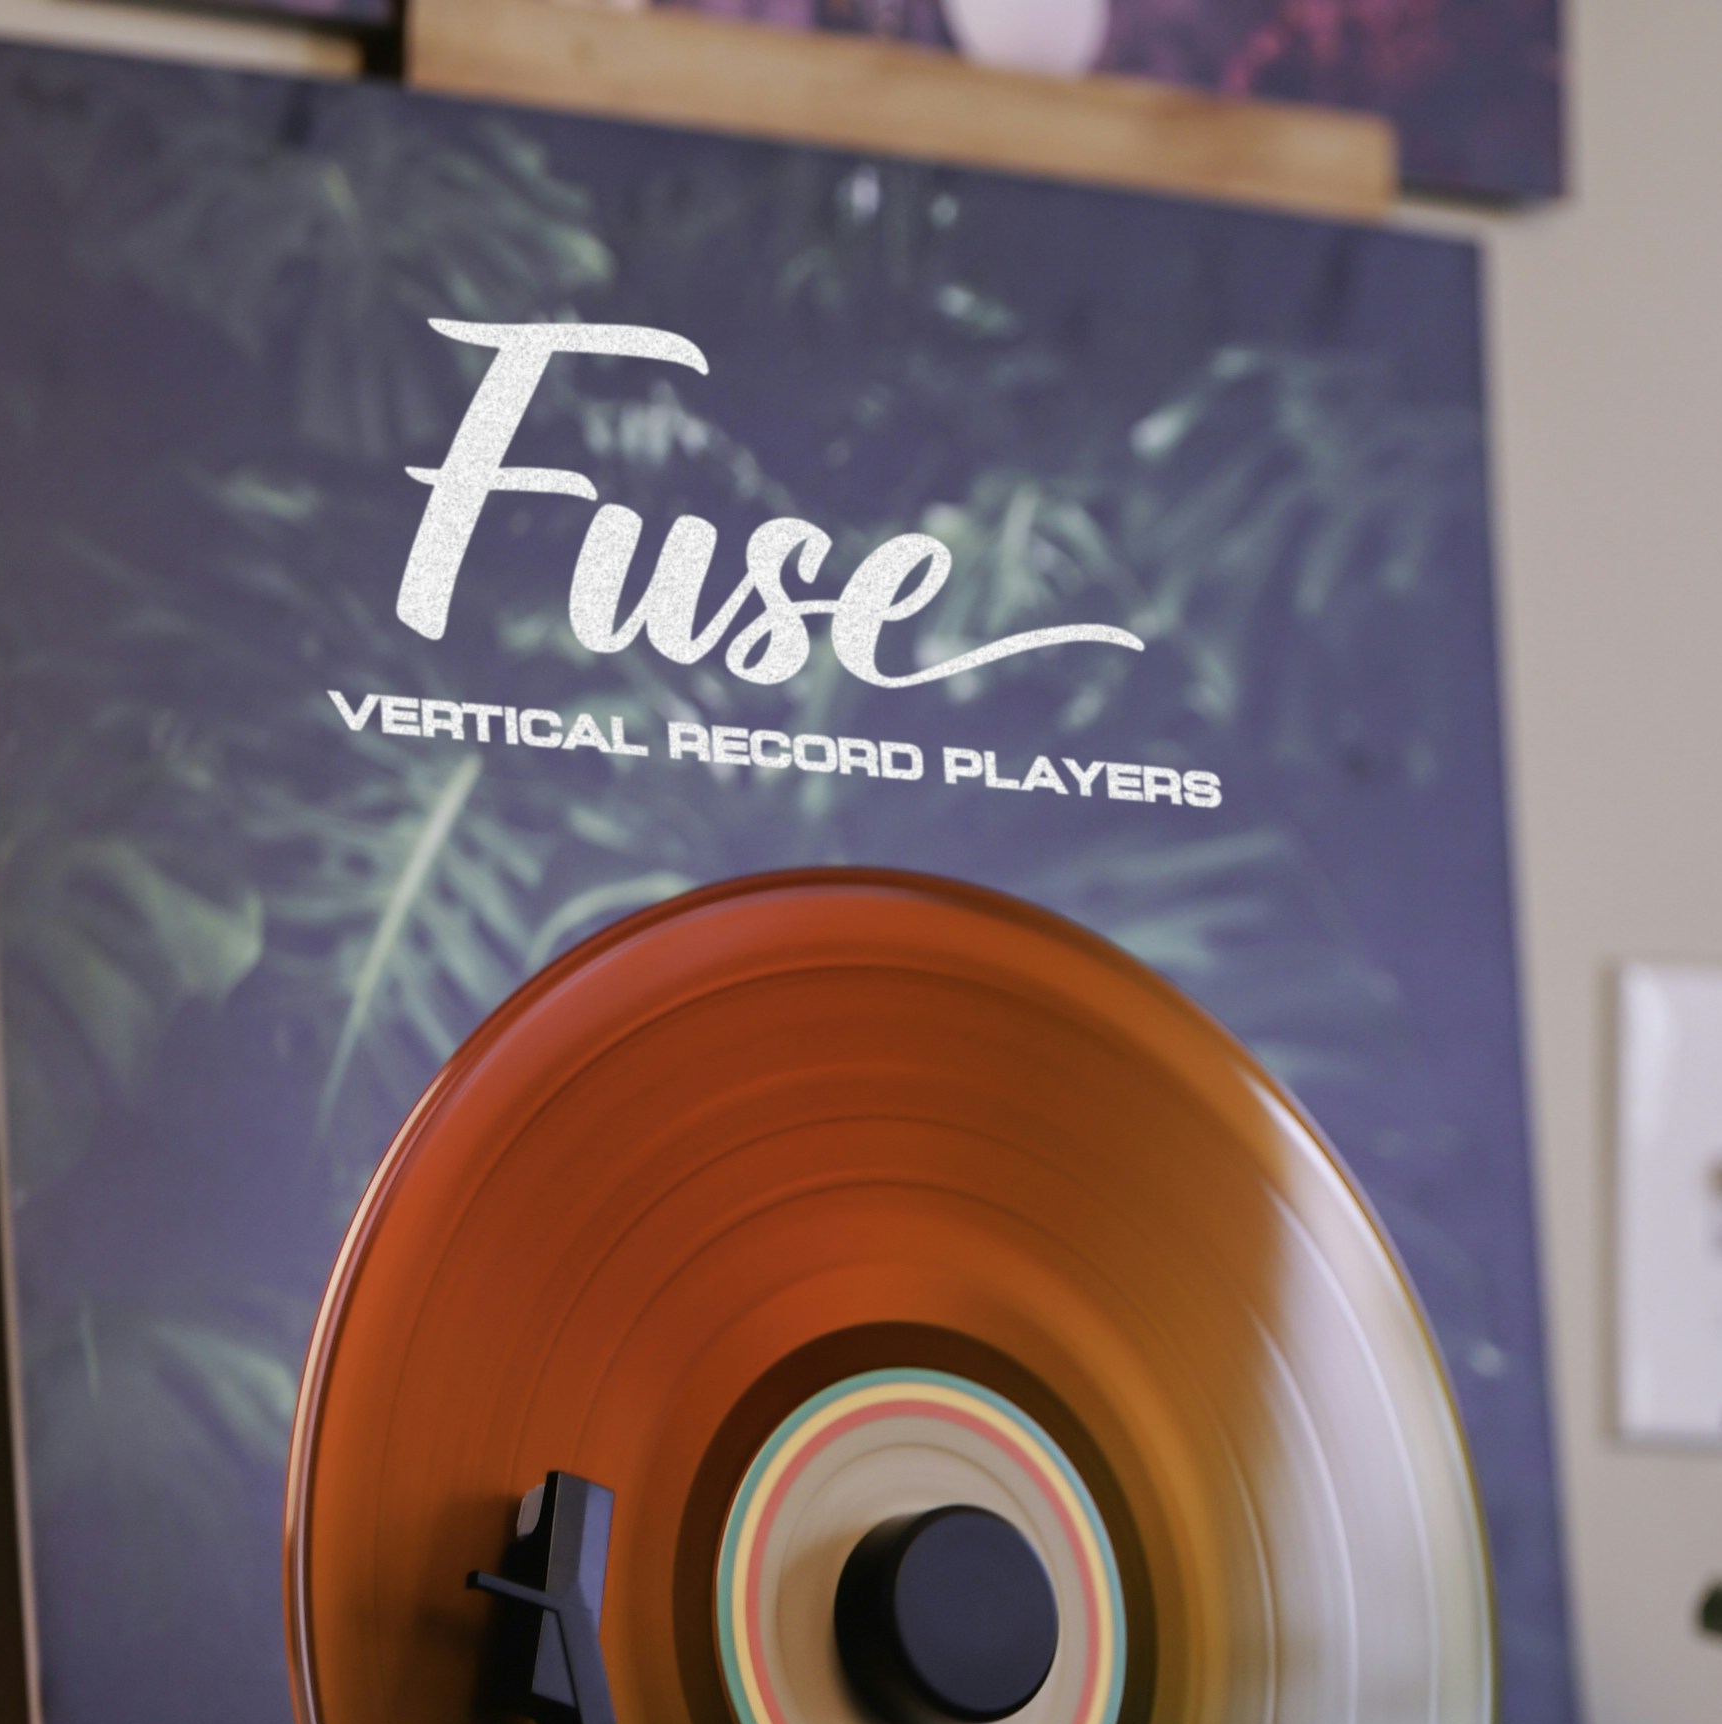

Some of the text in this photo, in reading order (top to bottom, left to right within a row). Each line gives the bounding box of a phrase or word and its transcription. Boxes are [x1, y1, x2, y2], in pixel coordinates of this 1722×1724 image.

[397, 318, 1145, 688] Fuse
[327, 689, 1223, 808] VERTICAL RECORD PLAYERS
